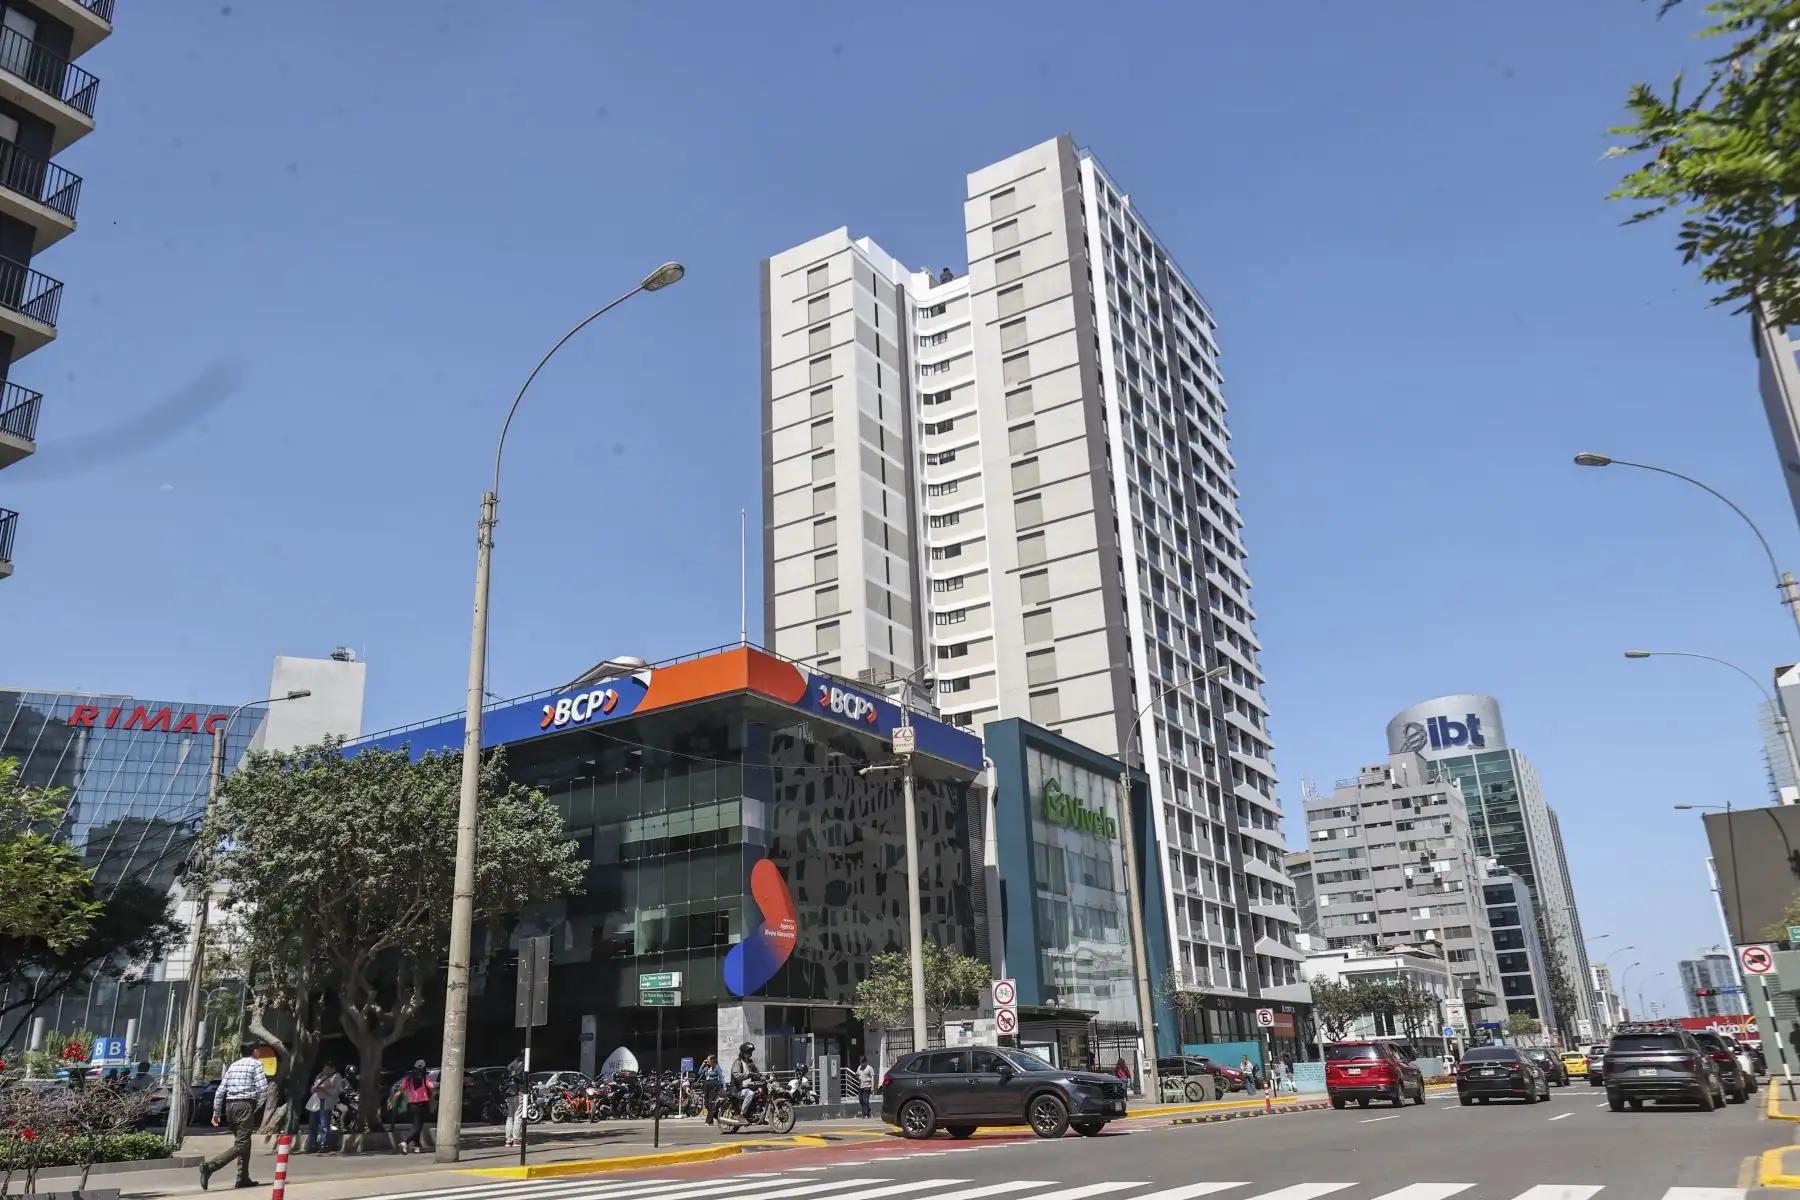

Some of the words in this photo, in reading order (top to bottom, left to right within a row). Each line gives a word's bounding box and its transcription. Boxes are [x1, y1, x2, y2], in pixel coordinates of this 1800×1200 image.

[67, 704, 228, 736] RIMAC
[553, 690, 605, 727] BCP
[830, 687, 868, 721] BCP
[1426, 713, 1485, 752] ibt
[96, 1042, 103, 1056] B
[109, 1041, 121, 1056] B
